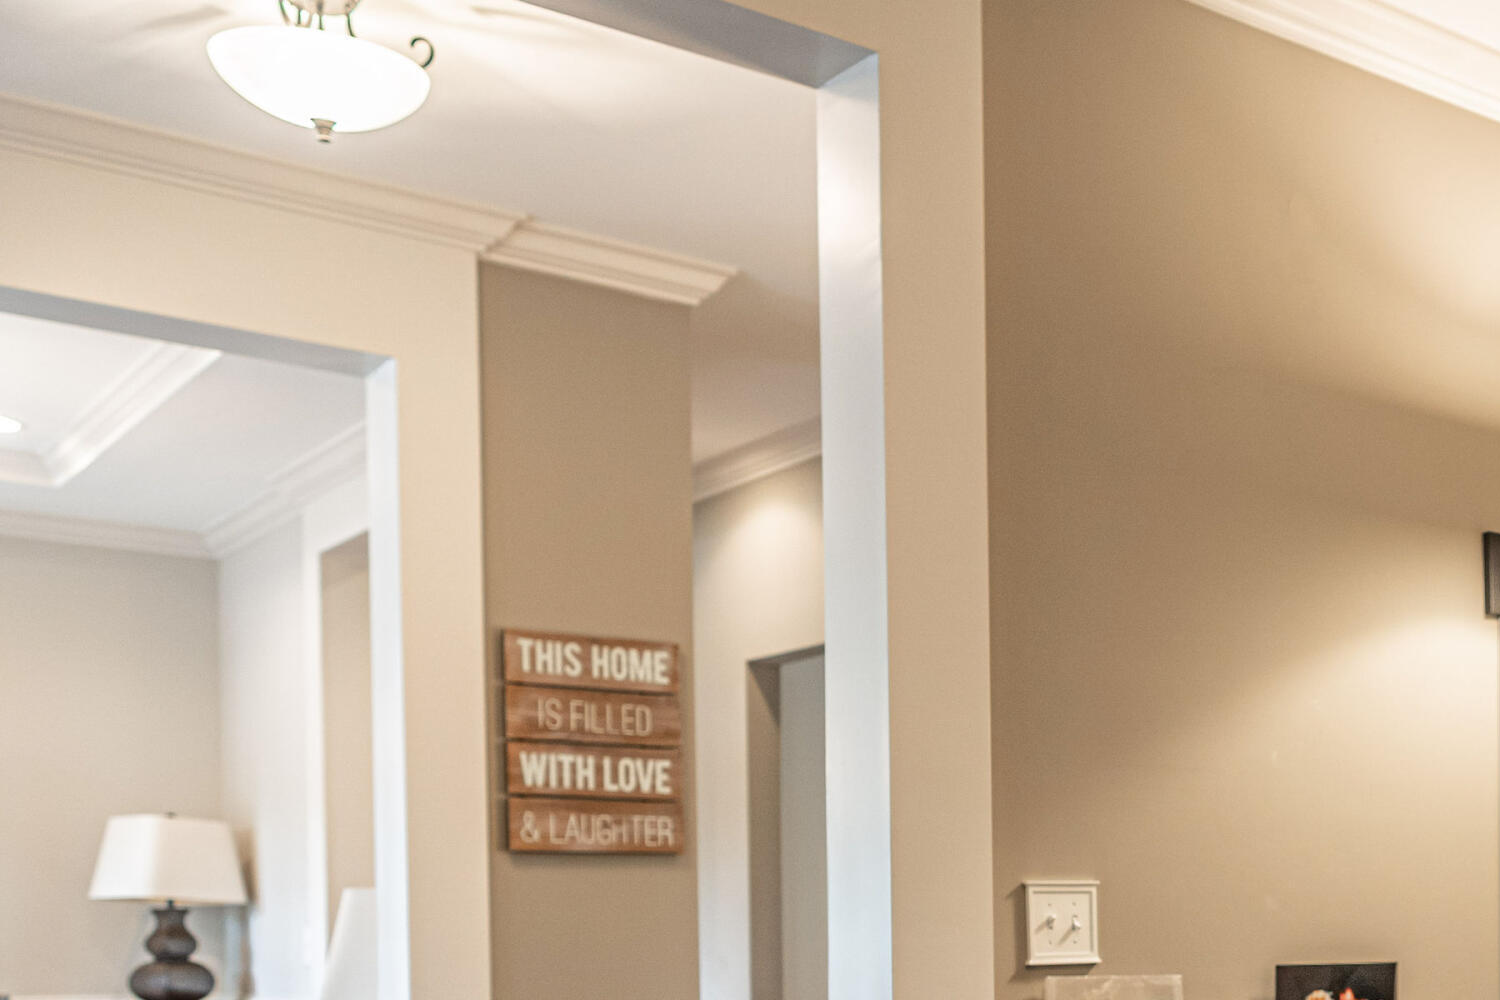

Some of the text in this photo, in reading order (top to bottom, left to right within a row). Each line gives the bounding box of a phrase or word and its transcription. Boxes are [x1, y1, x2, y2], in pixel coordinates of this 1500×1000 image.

[517, 637, 671, 686] THIS HOME
[537, 698, 652, 737] IS FILLED
[519, 751, 673, 796] WITH LOVE
[520, 810, 676, 848] & LAUGHTER
